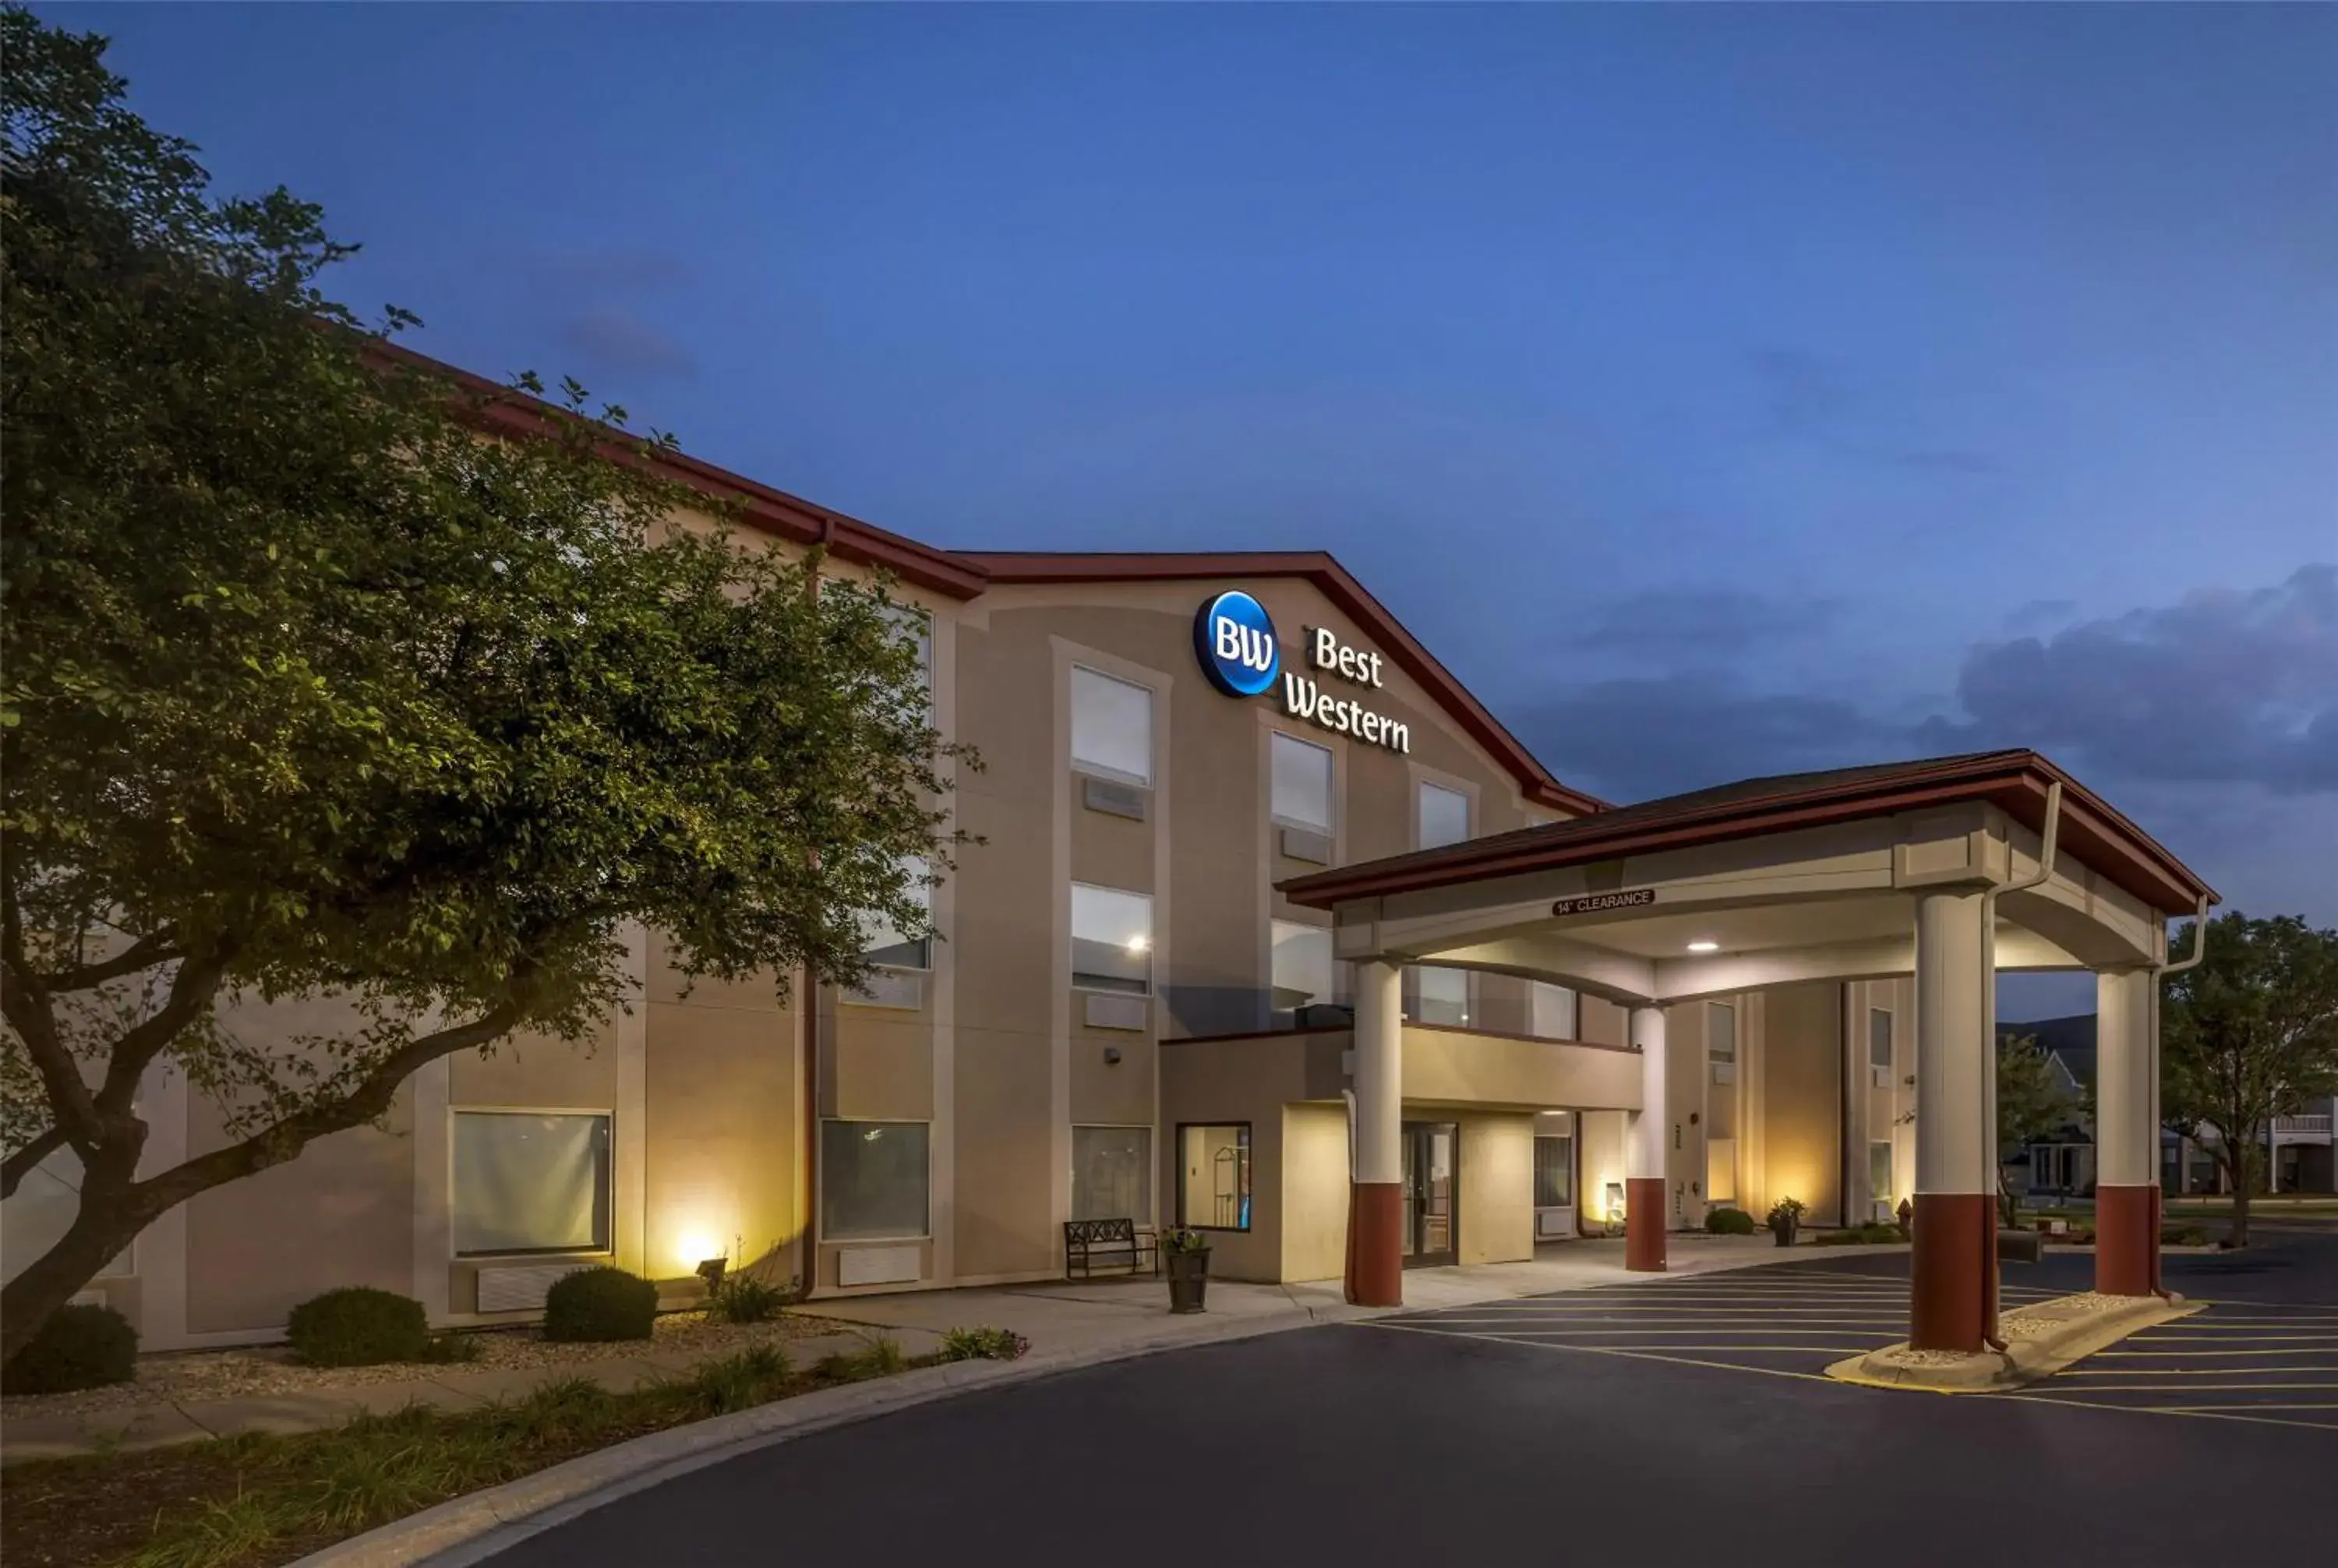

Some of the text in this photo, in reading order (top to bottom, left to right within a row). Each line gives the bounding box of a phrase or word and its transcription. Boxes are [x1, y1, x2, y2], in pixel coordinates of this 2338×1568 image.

[1217, 616, 1273, 672] BW
[1316, 627, 1383, 688] Best
[1285, 672, 1410, 754] Western
[1577, 891, 1651, 911] CLEARANCE
